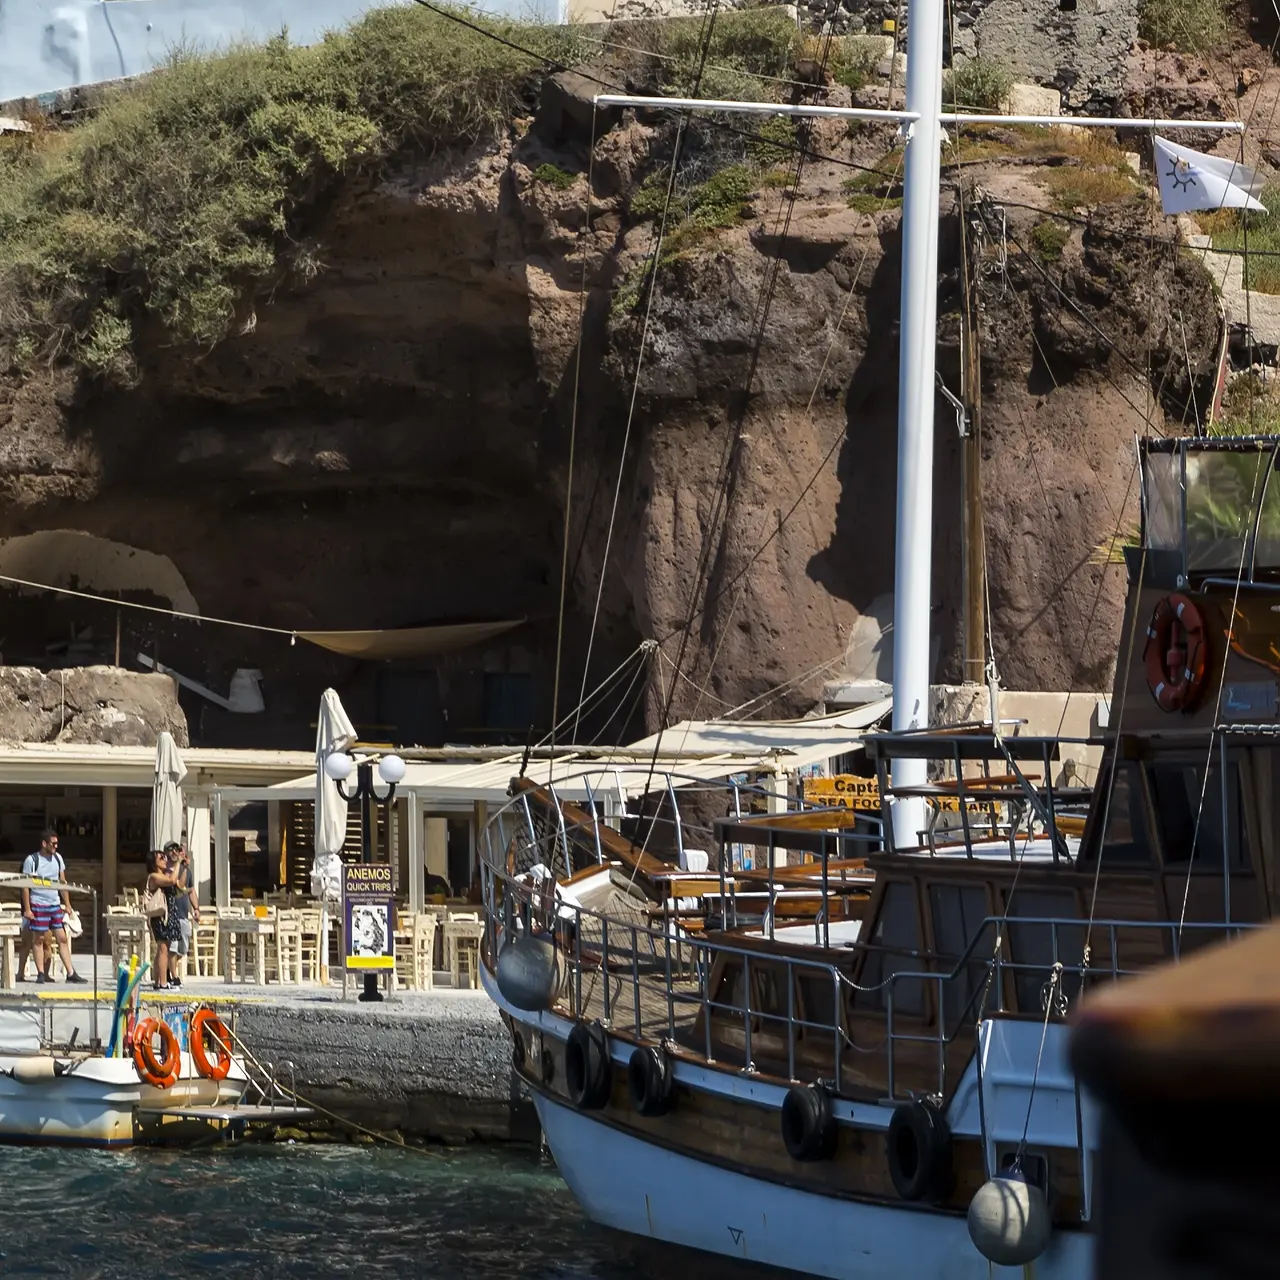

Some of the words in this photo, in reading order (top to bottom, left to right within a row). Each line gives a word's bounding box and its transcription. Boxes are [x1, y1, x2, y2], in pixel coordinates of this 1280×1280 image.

[834, 779, 880, 797] Capta
[818, 797, 848, 808] SEA
[852, 798, 882, 809] FOO
[347, 867, 391, 881] ANEMOS
[346, 882, 370, 892] QUICK
[371, 883, 392, 892] TRIPS
